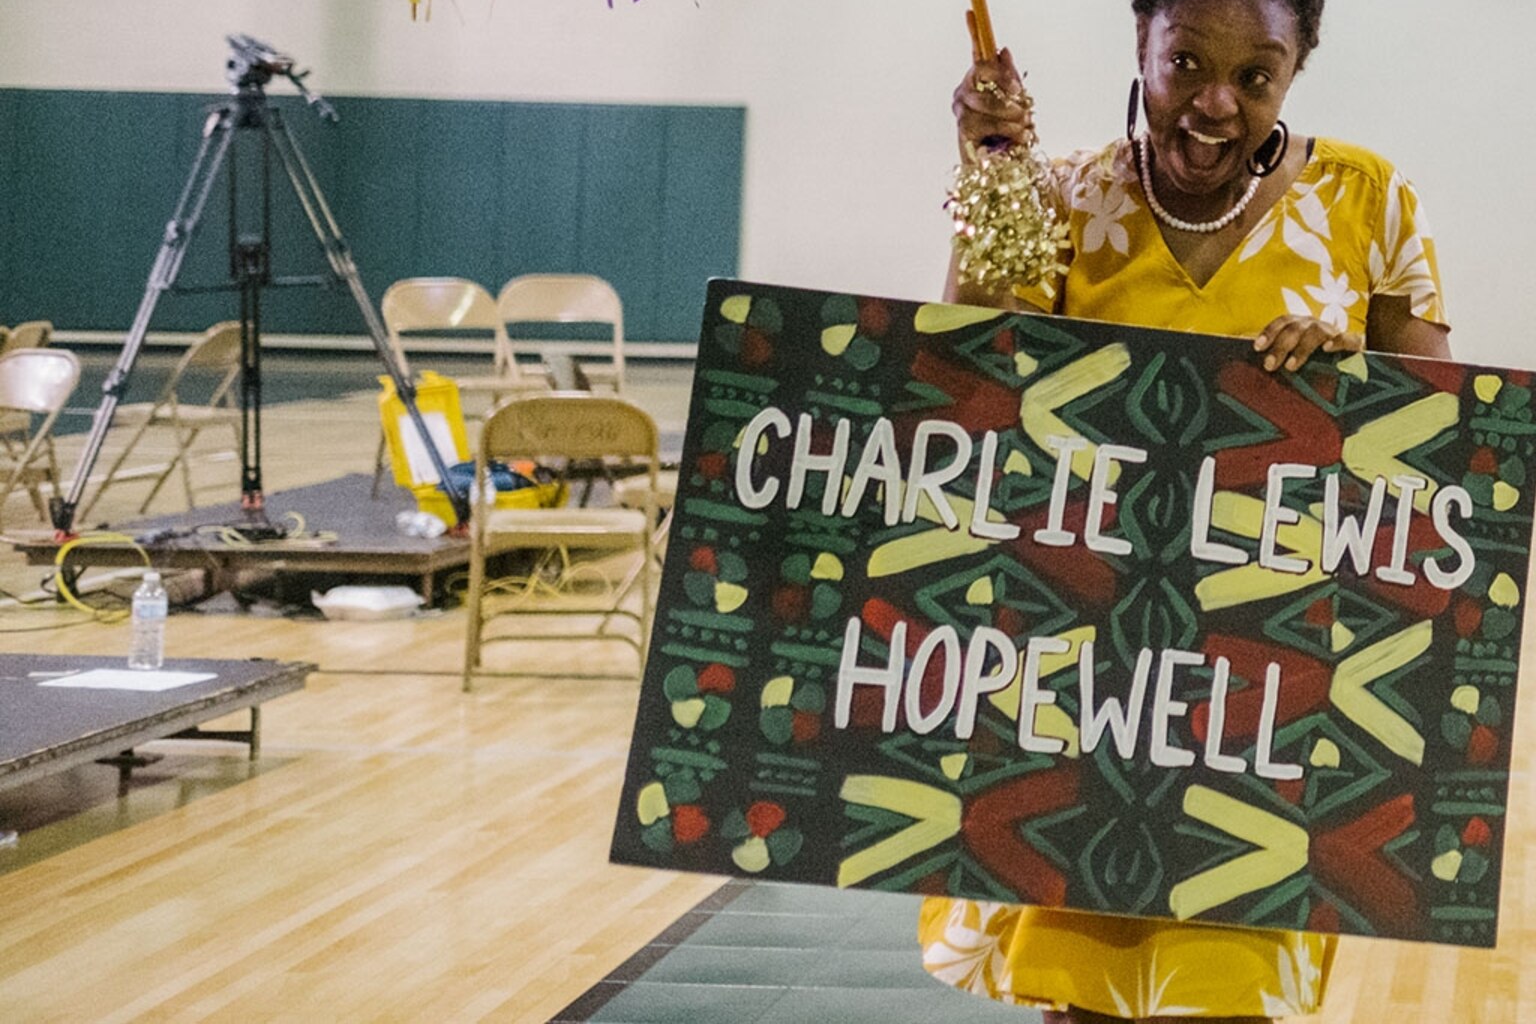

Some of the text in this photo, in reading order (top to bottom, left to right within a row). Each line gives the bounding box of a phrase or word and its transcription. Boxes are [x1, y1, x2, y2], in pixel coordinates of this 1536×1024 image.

[735, 406, 1476, 590] CHARLIE LEWIS
[834, 616, 1304, 781] HOPEWELL
